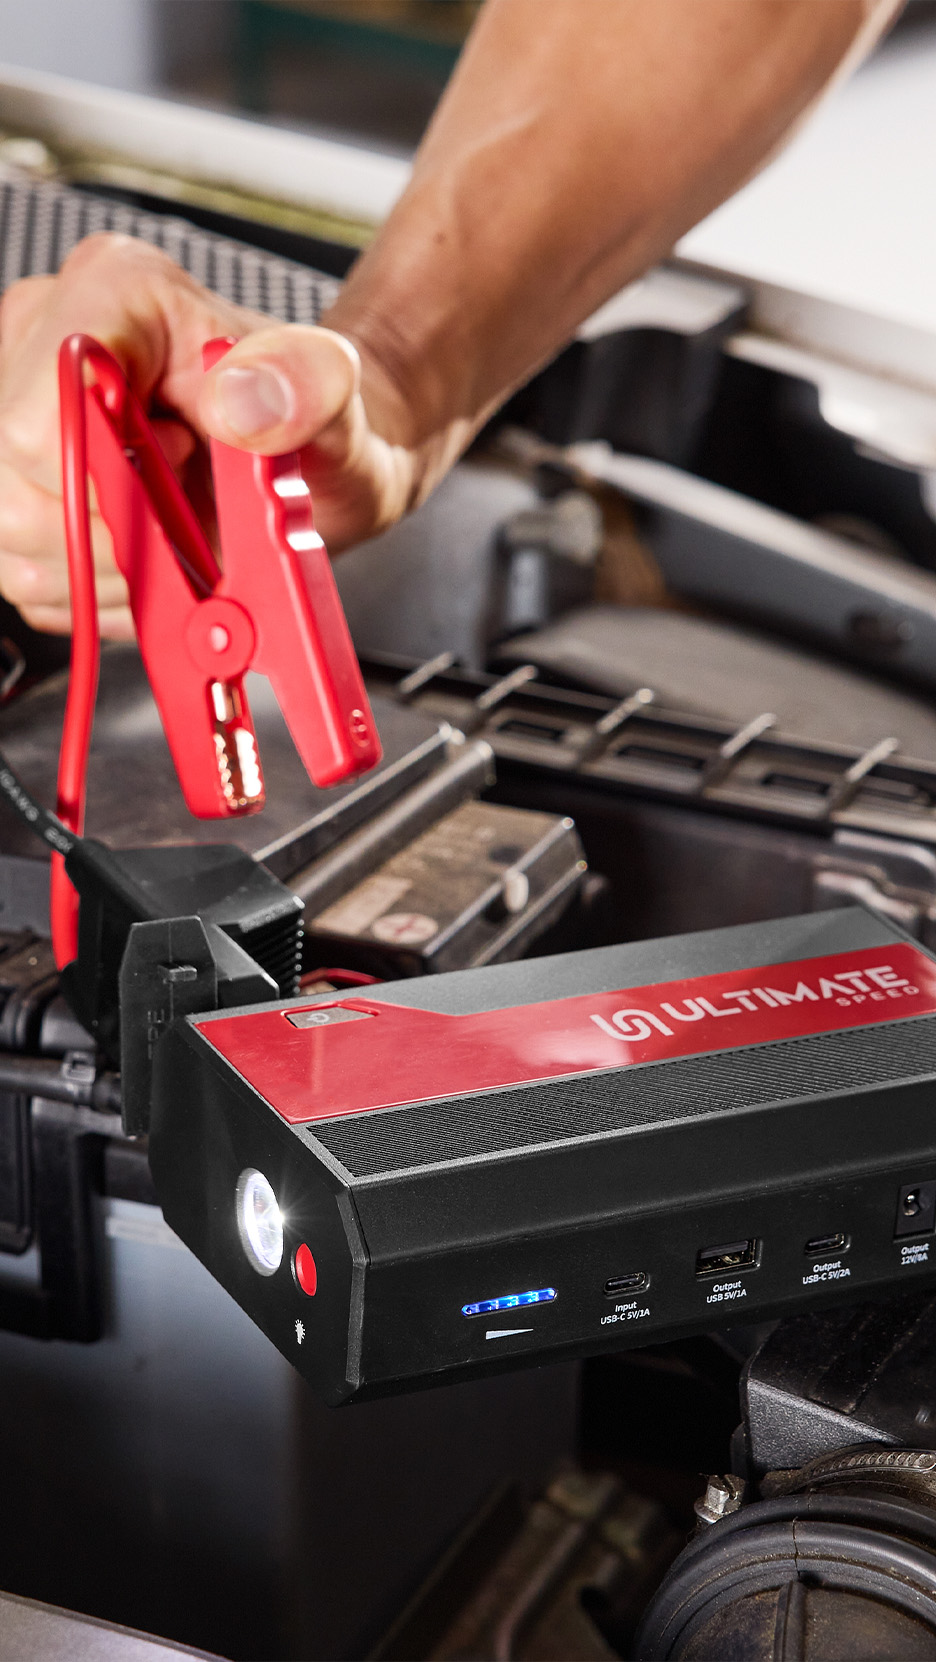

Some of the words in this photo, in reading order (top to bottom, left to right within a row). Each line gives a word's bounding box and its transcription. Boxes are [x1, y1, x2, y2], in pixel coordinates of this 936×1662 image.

[659, 965, 909, 1022] ULTIMATE
[835, 985, 920, 1007] SPEED
[900, 1243, 930, 1256] Output
[812, 1260, 842, 1273] Output
[802, 1272, 828, 1285] USB-C
[827, 1268, 851, 1280] 5V/2A
[712, 1280, 742, 1294] Output
[706, 1293, 724, 1304] USB
[723, 1288, 747, 1302] 5V/1A
[614, 1301, 638, 1314] Input
[600, 1312, 626, 1325] USB-C
[626, 1307, 651, 1321] 5V/1A
